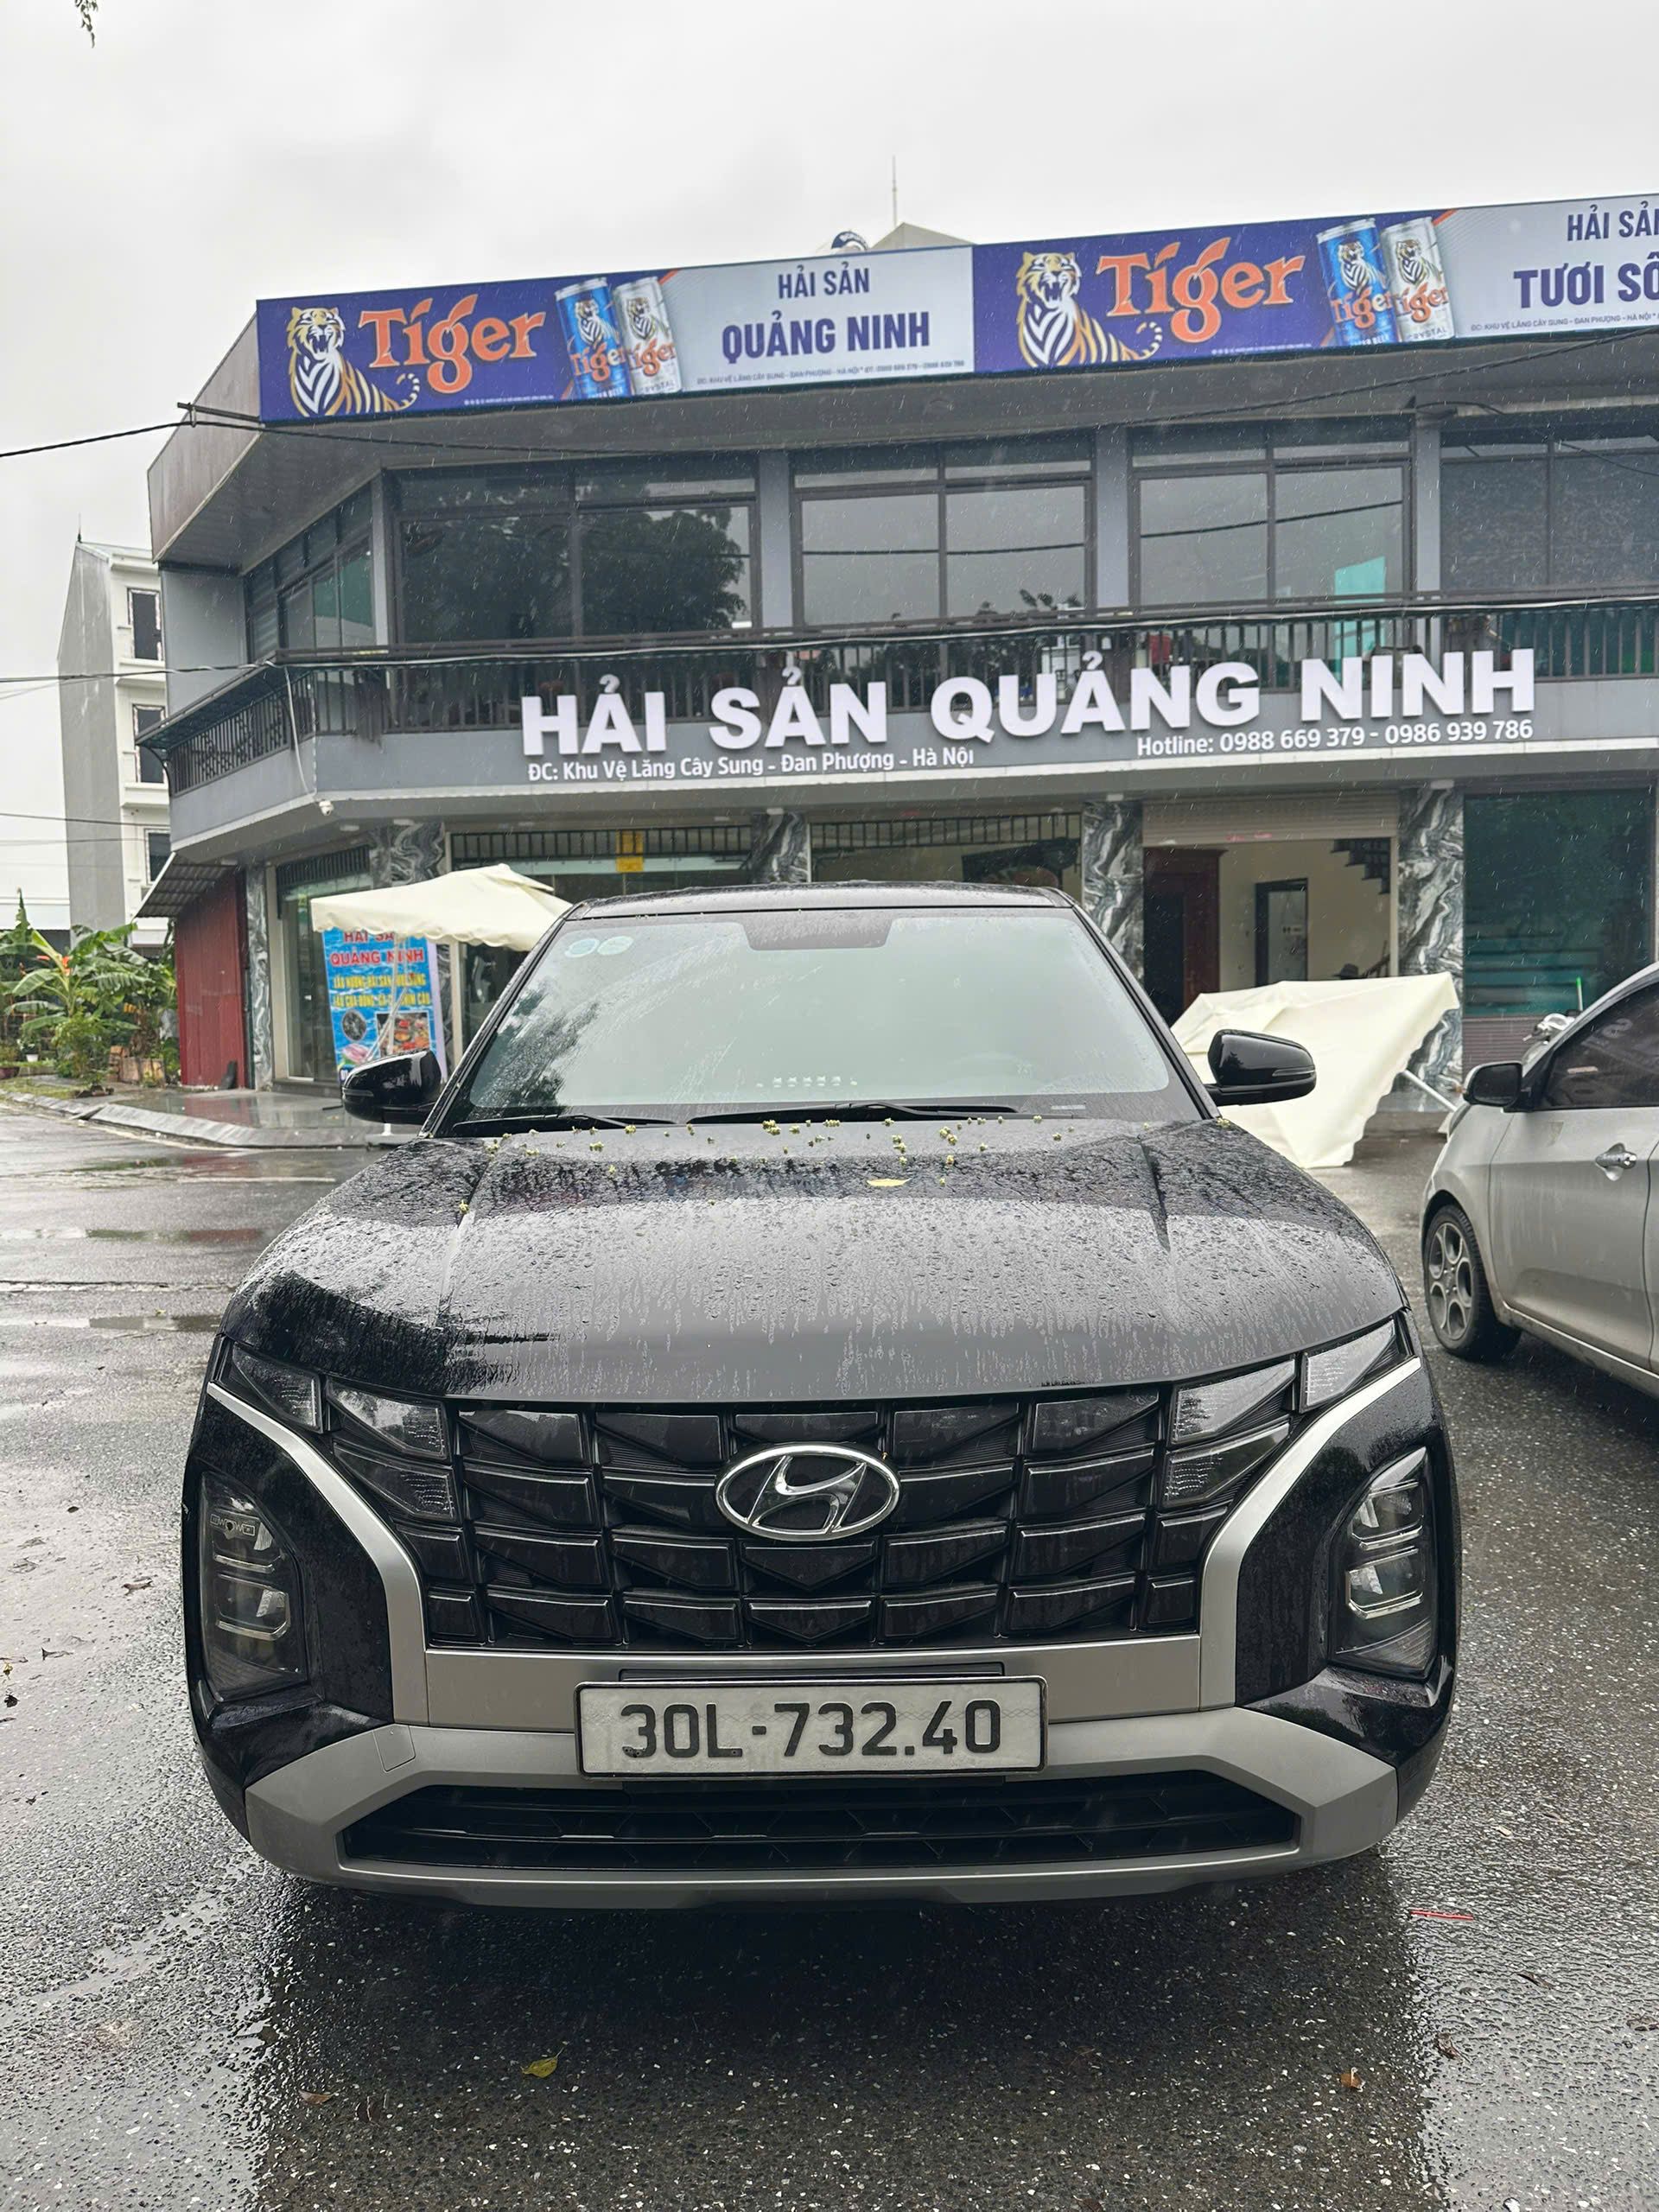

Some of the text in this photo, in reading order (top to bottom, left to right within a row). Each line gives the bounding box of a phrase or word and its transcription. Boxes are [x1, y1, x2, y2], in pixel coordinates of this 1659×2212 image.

[1567, 204, 1610, 241] HẢI
[779, 261, 870, 299] HẢI SẢN
[1096, 237, 1306, 343] Tiger
[1513, 261, 1605, 308] TƯƠI
[357, 294, 547, 394] Tiger
[721, 310, 931, 364] QUẢNG NINH
[521, 648, 1535, 756] HẢI SẢN QUẢNG NINH
[1137, 736, 1213, 757] Hotline:
[1219, 731, 1274, 752] 0988
[1280, 729, 1321, 749] 669
[1326, 727, 1365, 747] 379
[1384, 723, 1441, 744] 0986
[1446, 721, 1487, 741] 939
[1492, 719, 1534, 740] 786
[528, 762, 558, 781] ĐC:
[563, 761, 598, 780] Khu
[602, 760, 627, 782] Vệ
[632, 759, 675, 779] Lăng
[680, 757, 713, 778] Cây
[718, 756, 763, 776] Sung
[780, 753, 817, 772] Đan
[822, 752, 894, 772] Phượng
[912, 747, 938, 766] Hà
[943, 747, 974, 767] Nội
[620, 1699, 1001, 1758] 30L-732.40
